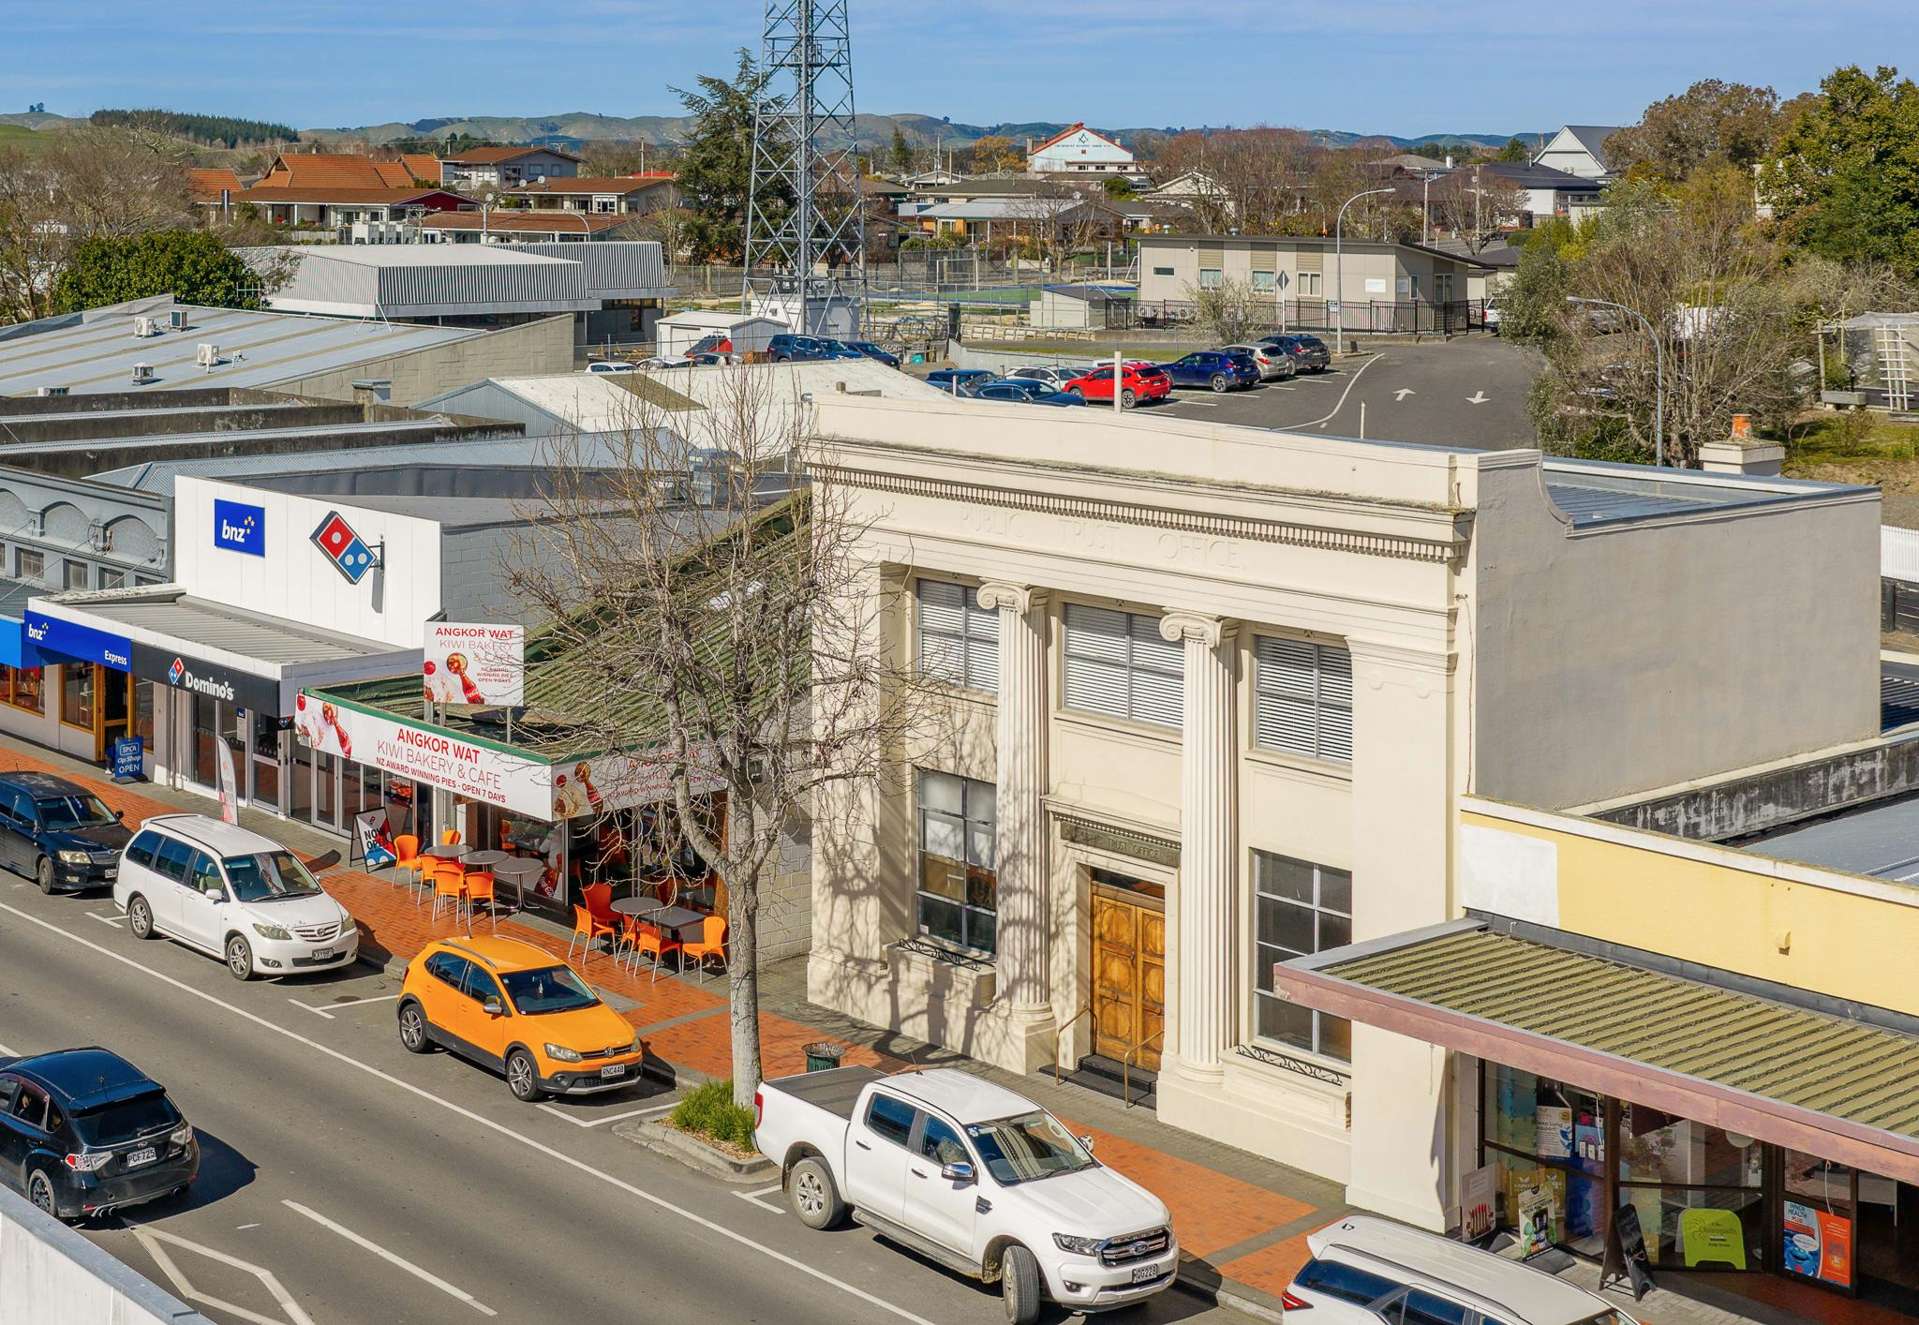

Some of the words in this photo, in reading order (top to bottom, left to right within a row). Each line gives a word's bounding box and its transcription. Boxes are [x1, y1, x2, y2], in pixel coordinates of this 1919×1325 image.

[221, 518, 246, 543] bnz
[28, 623, 43, 641] bnz
[435, 627, 486, 638] ANGKOR
[488, 629, 515, 640] WAT
[440, 639, 466, 649] KIWI
[104, 649, 128, 666] Express
[185, 671, 235, 701] Domino's
[397, 728, 449, 756] ANGKOR
[452, 743, 480, 764] WAT
[119, 764, 140, 774] OPEN
[377, 739, 403, 759] KIWI
[406, 748, 454, 775] BAKERY
[457, 763, 466, 779] &
[468, 766, 502, 790] CAFE
[375, 756, 385, 767] NZ
[386, 760, 410, 774] AWARD
[411, 767, 440, 784] WINNING
[441, 777, 456, 789] PIES
[461, 783, 481, 796] OPEN
[482, 789, 487, 797] 7
[487, 791, 507, 803] DAYS
